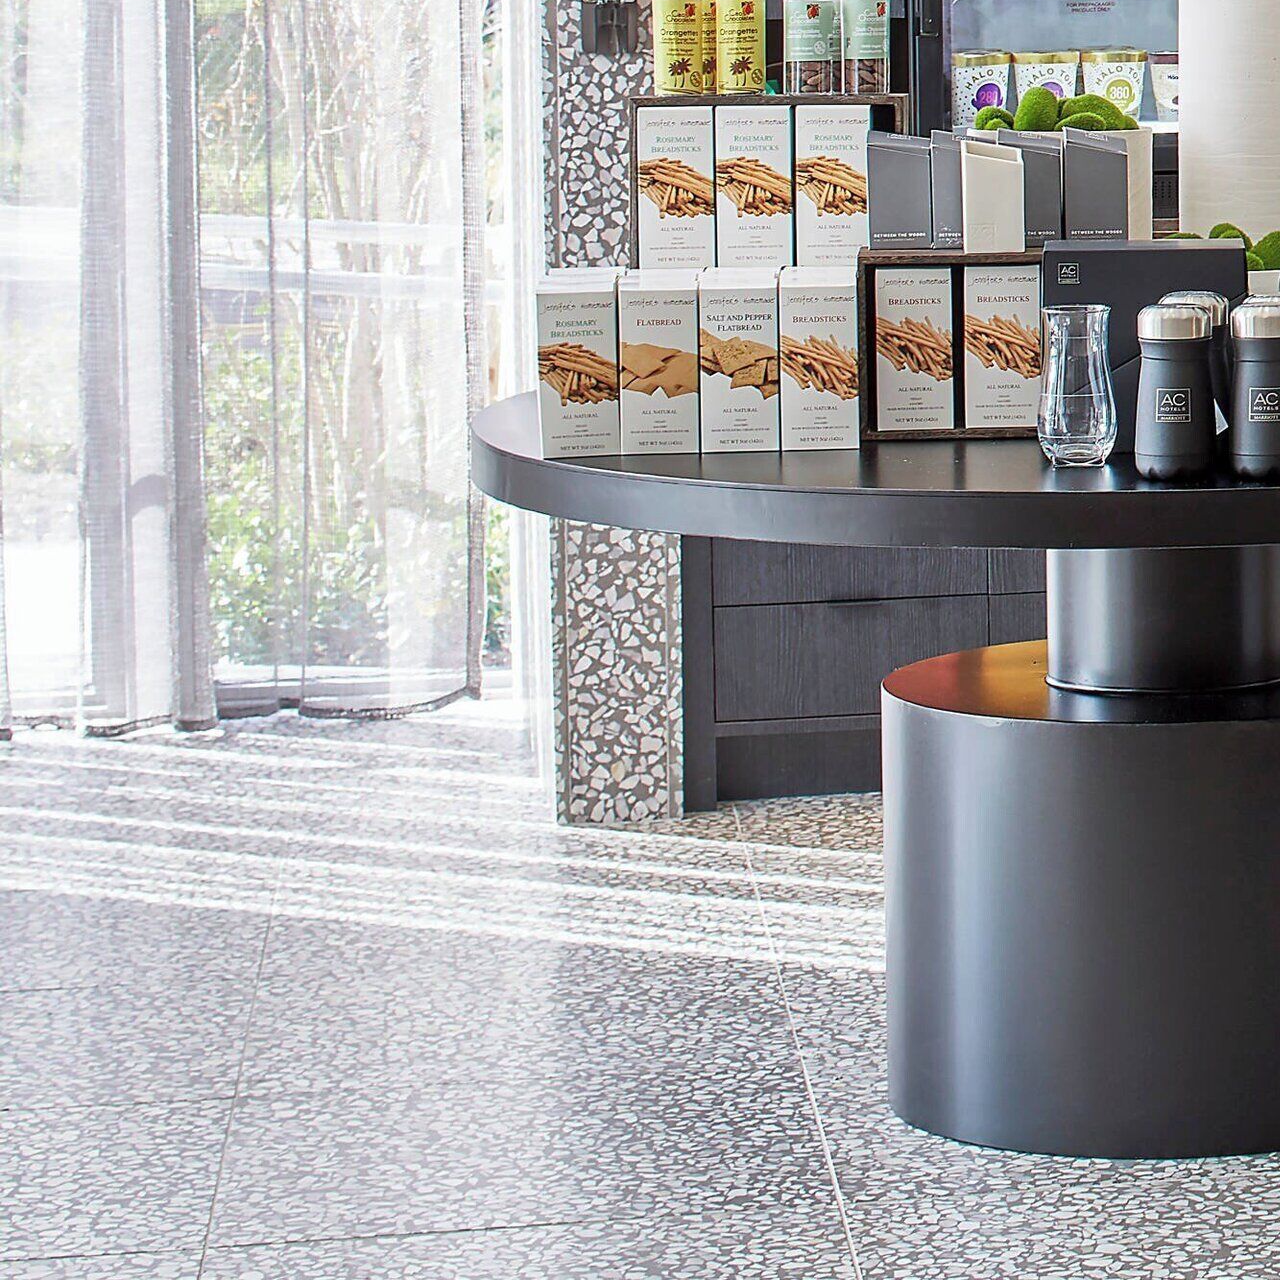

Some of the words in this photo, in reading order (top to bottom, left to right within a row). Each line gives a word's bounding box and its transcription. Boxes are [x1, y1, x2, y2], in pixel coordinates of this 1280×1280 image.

[660, 29, 698, 37] Orangettes
[965, 68, 994, 90] HALO
[1027, 67, 1054, 88] HALO
[1096, 65, 1123, 86] HALO
[1062, 266, 1076, 274] AC
[888, 298, 941, 306] BREADSTICKS
[977, 295, 1030, 303] BREADSTICKS
[727, 314, 743, 322] AND
[745, 313, 772, 321] PEPPER
[792, 315, 847, 323] BREADSTICKS
[555, 319, 597, 327] ROSEMARY
[636, 319, 681, 327] FLATBREAD
[717, 324, 762, 332] FLATBREAD
[550, 329, 603, 338] BREADSTICKS
[1161, 393, 1186, 405] AC
[1254, 393, 1279, 405] AC
